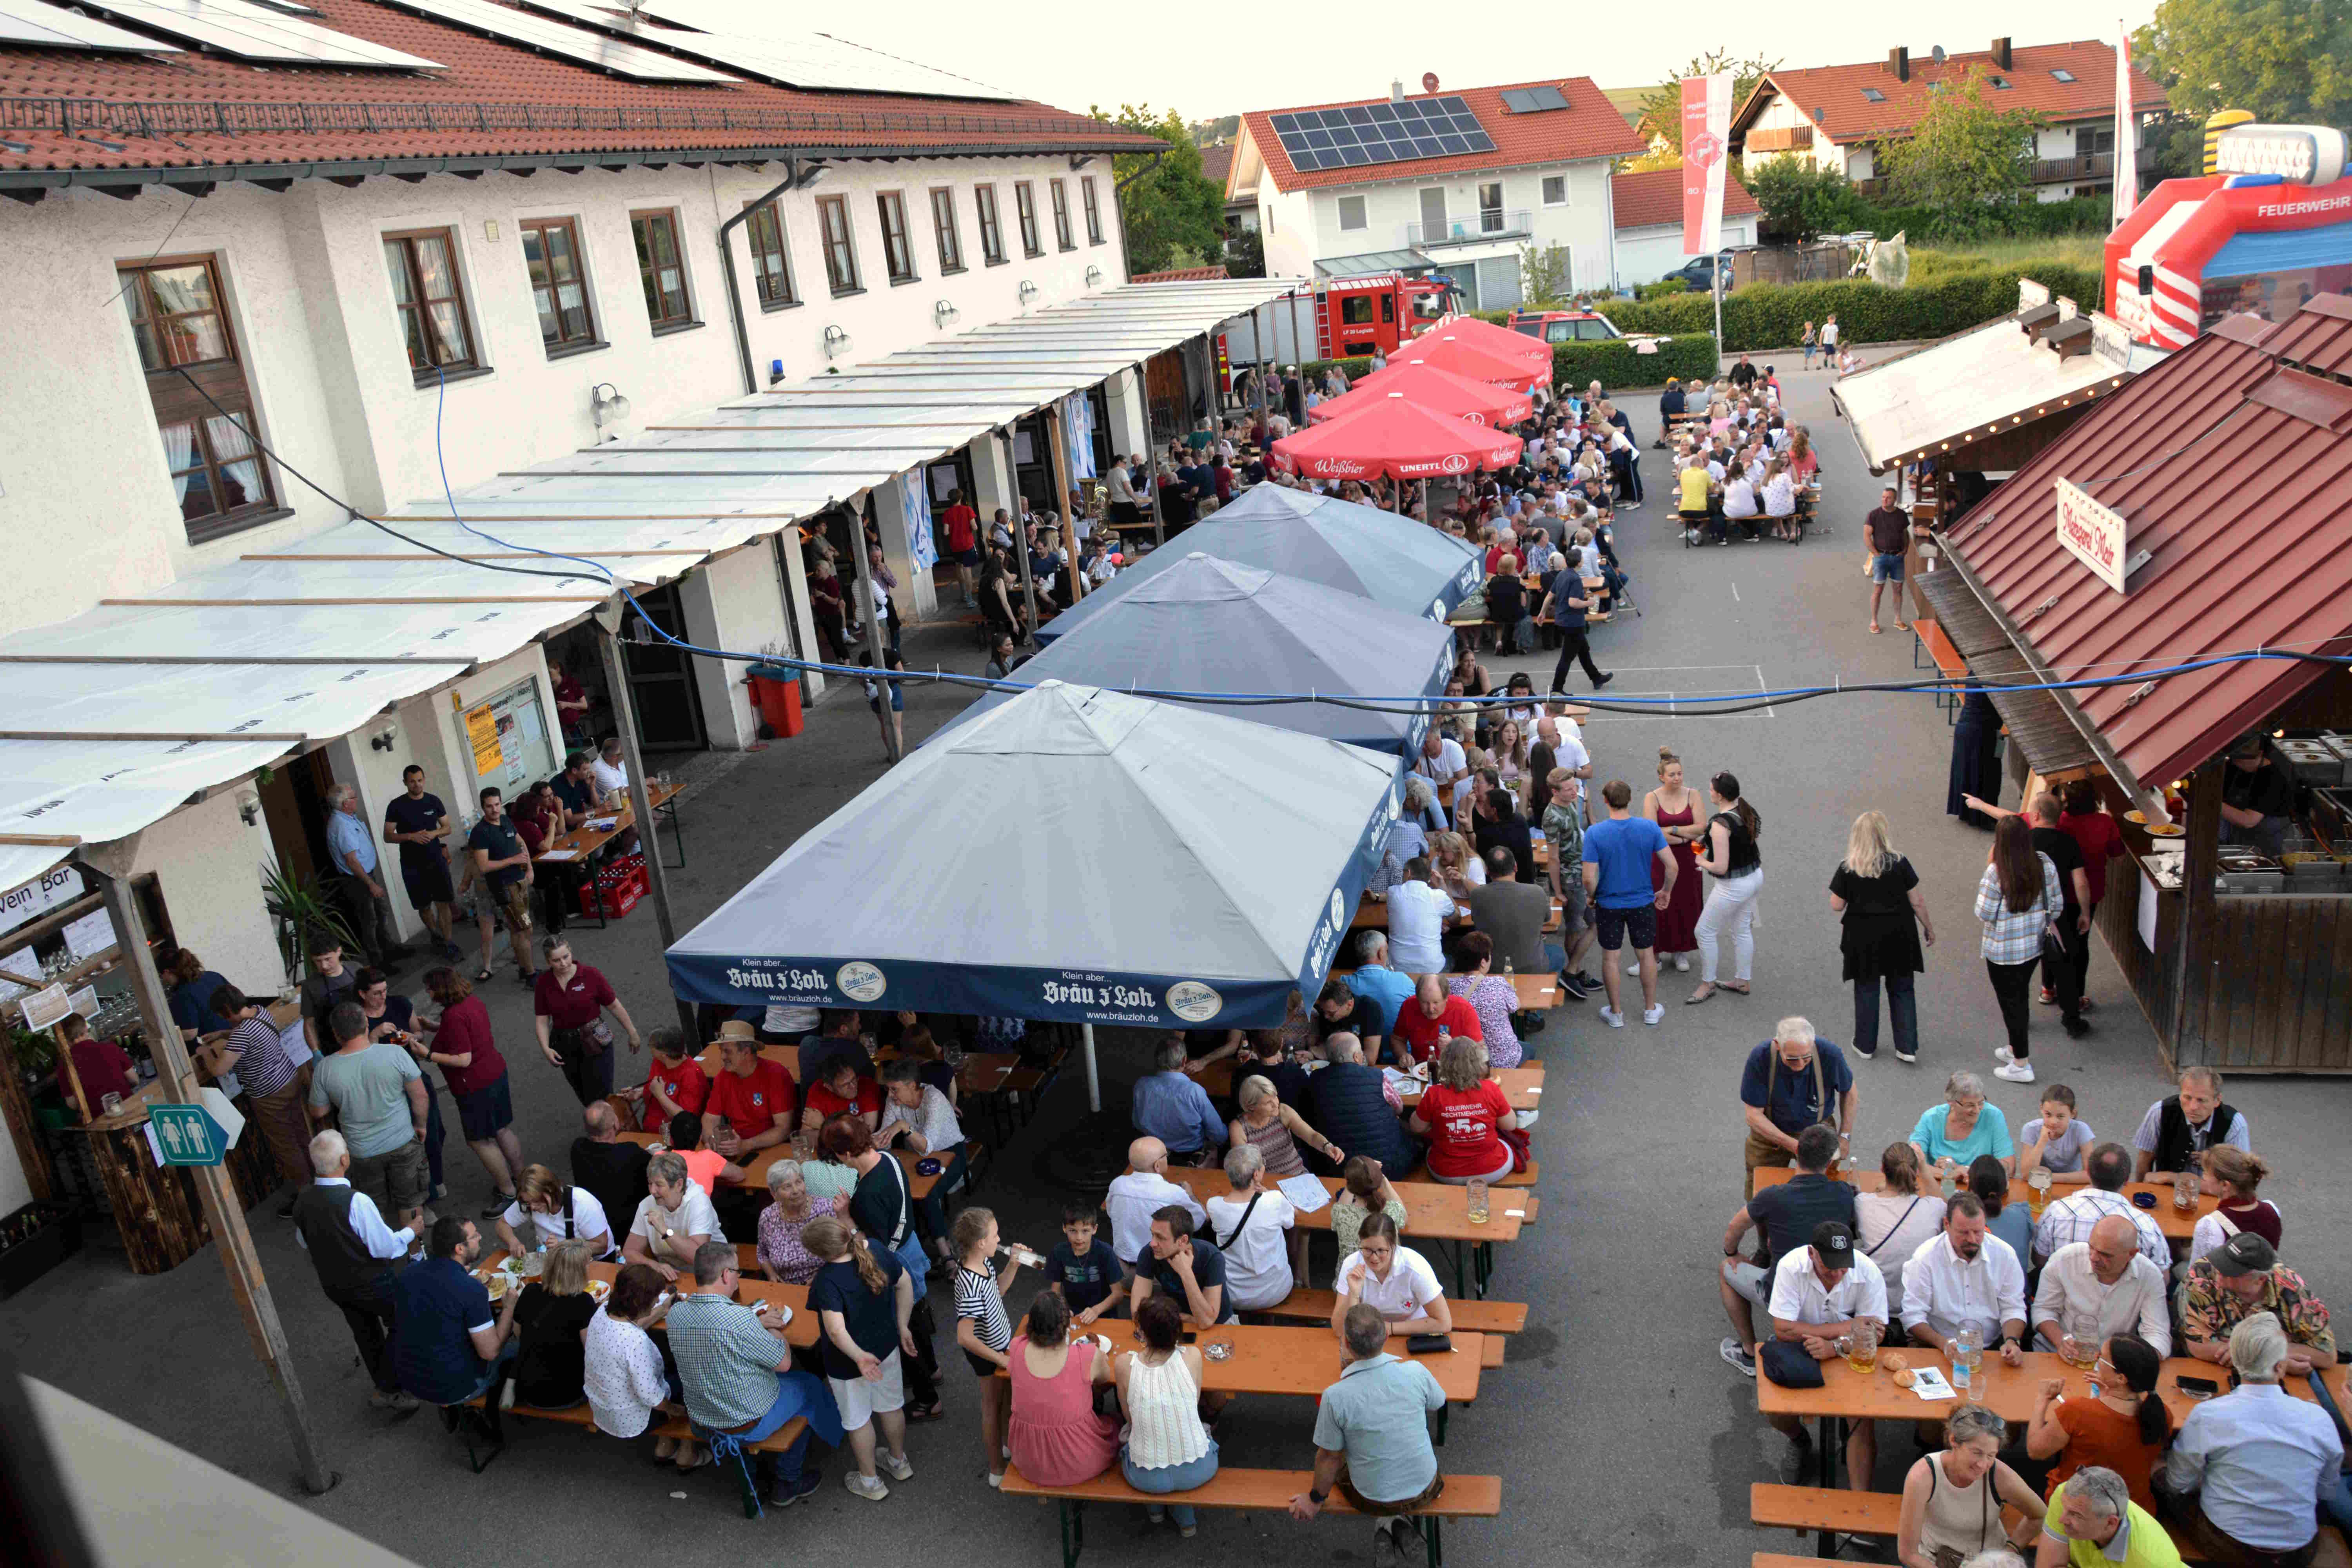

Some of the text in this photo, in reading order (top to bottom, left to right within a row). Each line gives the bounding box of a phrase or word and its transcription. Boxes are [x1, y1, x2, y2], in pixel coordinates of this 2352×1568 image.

[2258, 196, 2351, 217] FEUERWEHR
[1314, 457, 1365, 477] Weißbier
[1399, 462, 1441, 472] UNERTL
[40, 868, 70, 892] Bar
[742, 958, 787, 967] Klein aber...
[726, 968, 775, 988] Bräu
[790, 969, 828, 991] Loh
[1062, 971, 1112, 982] Klein aber...
[768, 994, 833, 1004] www.bräuzloh.de
[1042, 981, 1095, 1004] Bräu
[1113, 985, 1156, 1008] Loh
[1086, 1011, 1159, 1022] www.bräuzloh.de
[1445, 1103, 1482, 1112] FEUERWEHR
[1441, 1109, 1488, 1118] RECHTMEHRING
